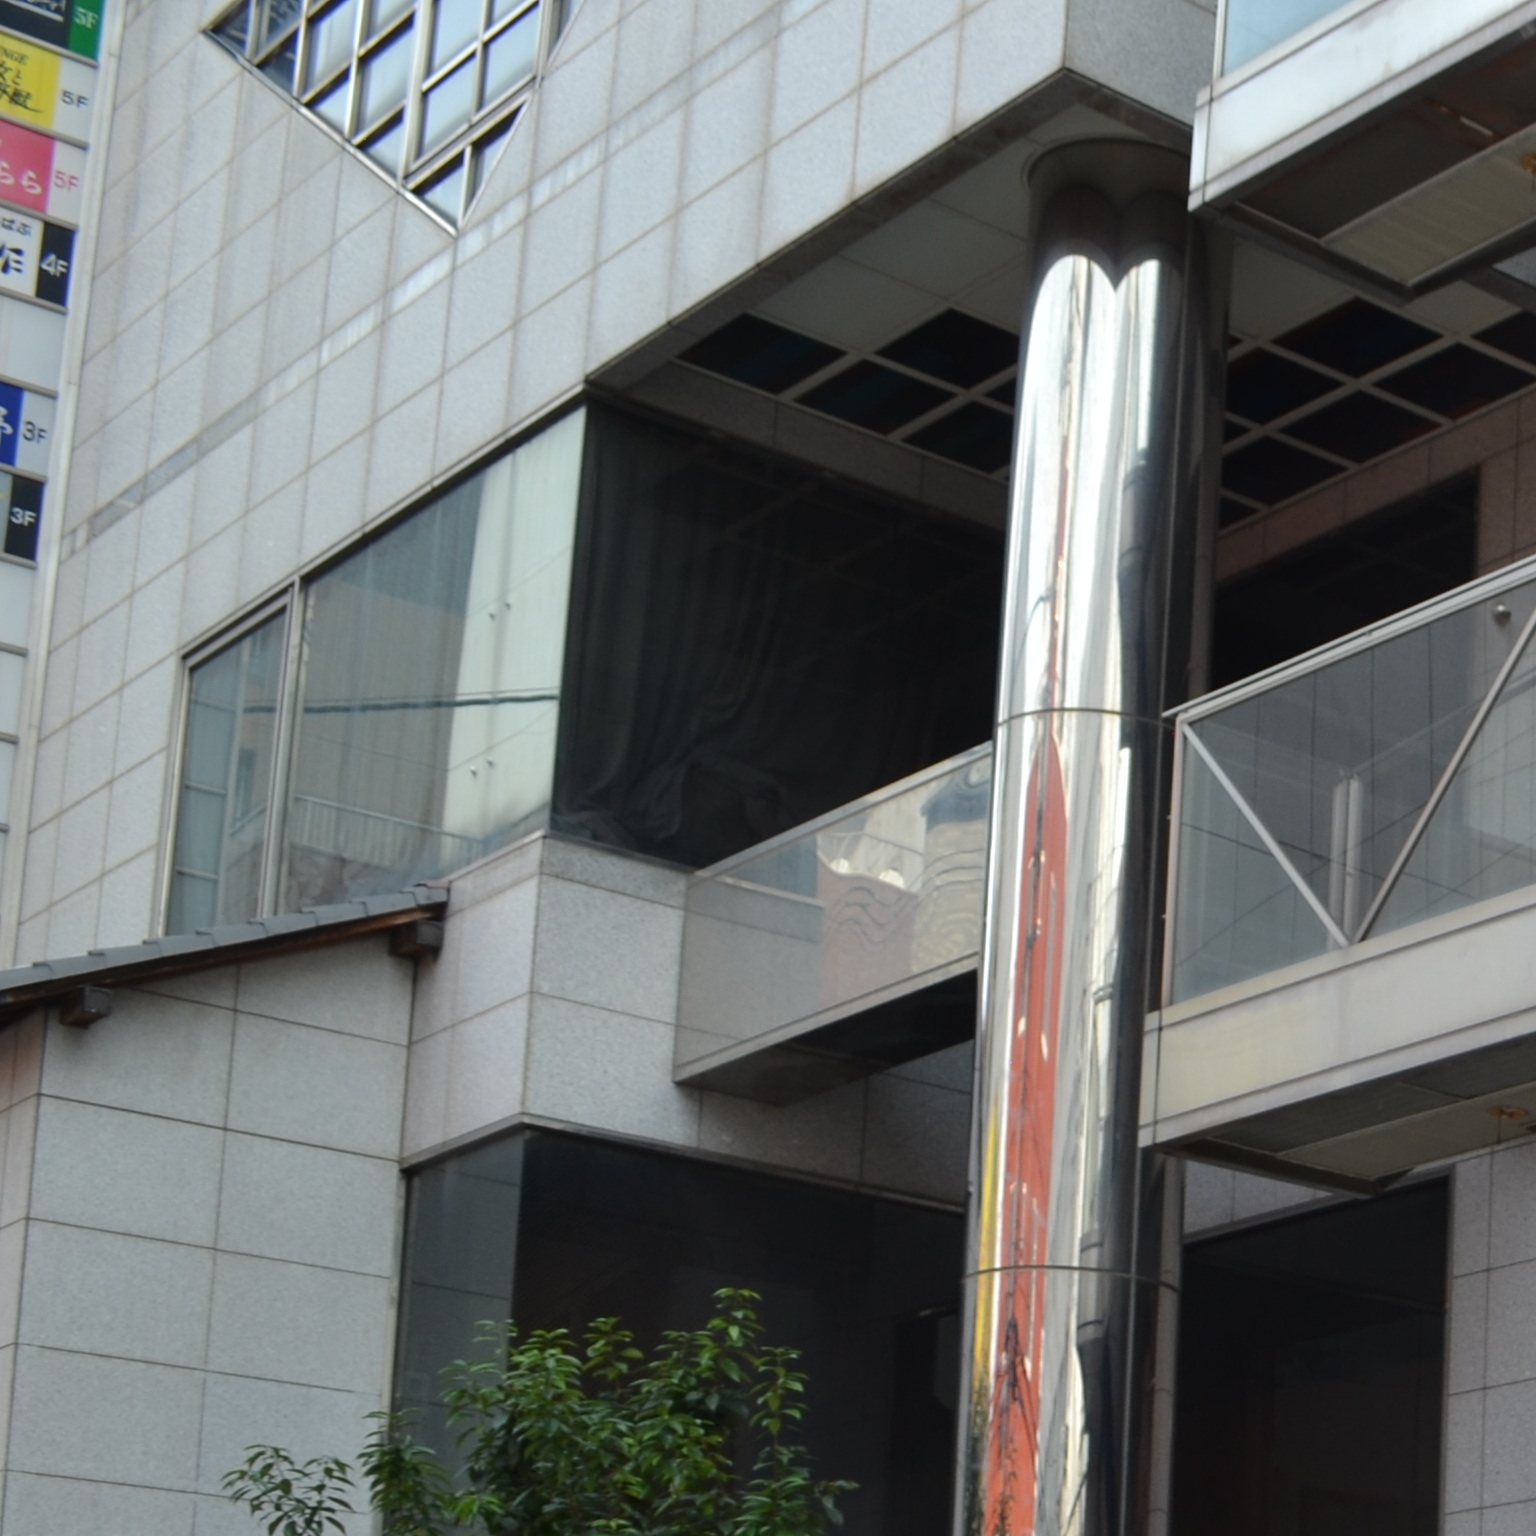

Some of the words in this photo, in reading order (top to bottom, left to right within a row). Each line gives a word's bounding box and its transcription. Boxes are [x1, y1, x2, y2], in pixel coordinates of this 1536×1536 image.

[73, 6, 99, 30] 5F
[60, 90, 88, 109] 5F
[53, 170, 79, 191] 5F
[40, 254, 69, 279] 4F
[22, 420, 48, 444] 3F
[10, 506, 37, 528] 3F
